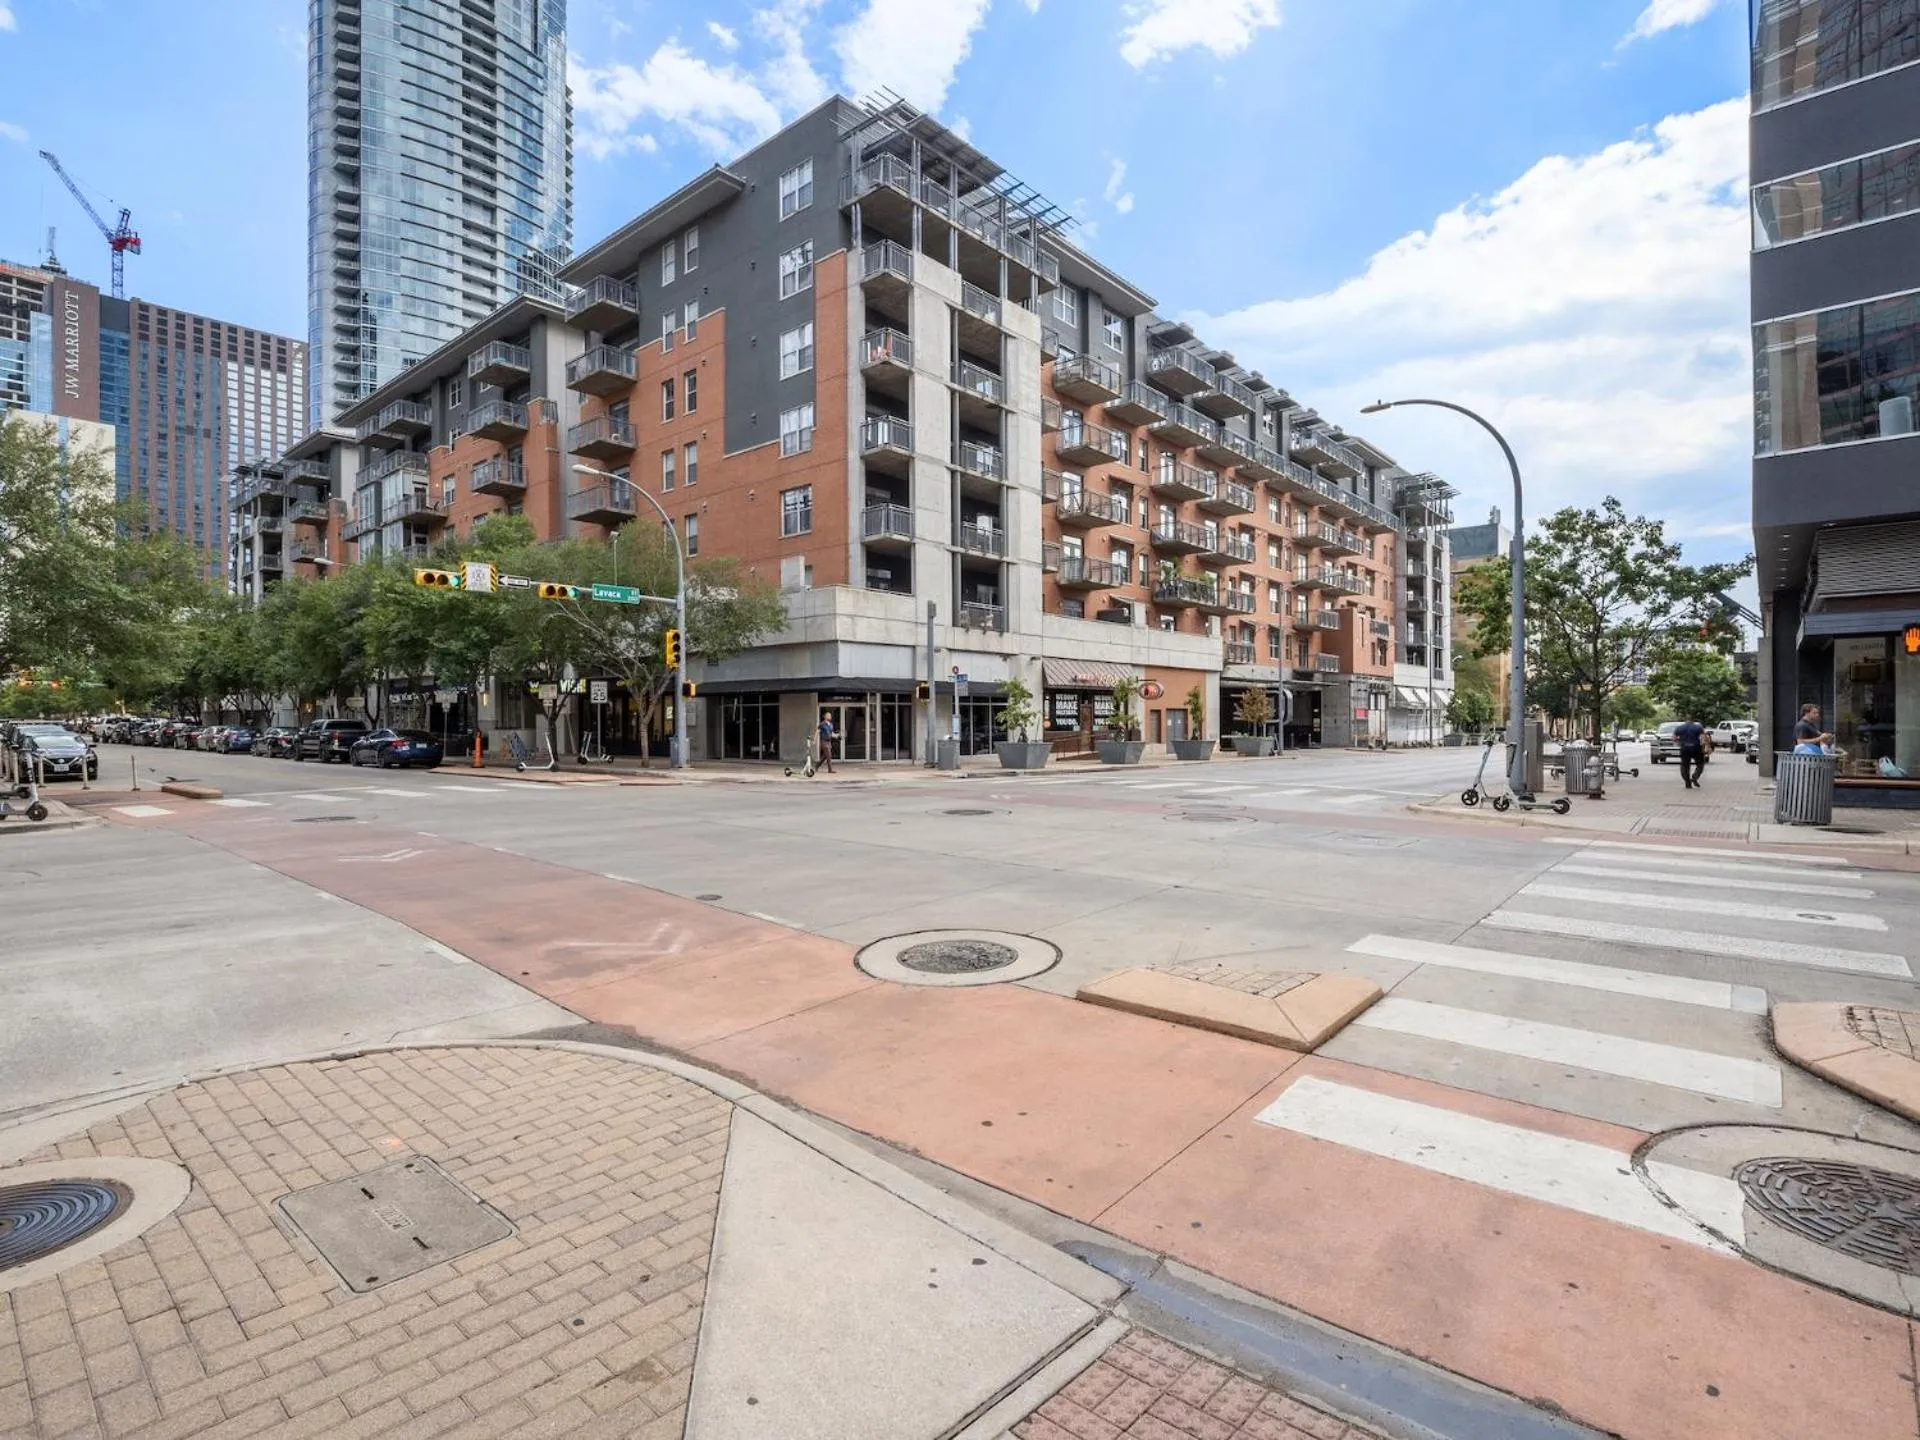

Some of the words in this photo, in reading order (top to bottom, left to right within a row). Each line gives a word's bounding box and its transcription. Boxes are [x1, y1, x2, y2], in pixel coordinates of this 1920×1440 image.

[64, 290, 79, 372] MARRIOTT
[64, 374, 79, 399] JW
[594, 588, 622, 598] Lavaca
[593, 692, 606, 701] 25
[1055, 700, 1079, 710] MAKE
